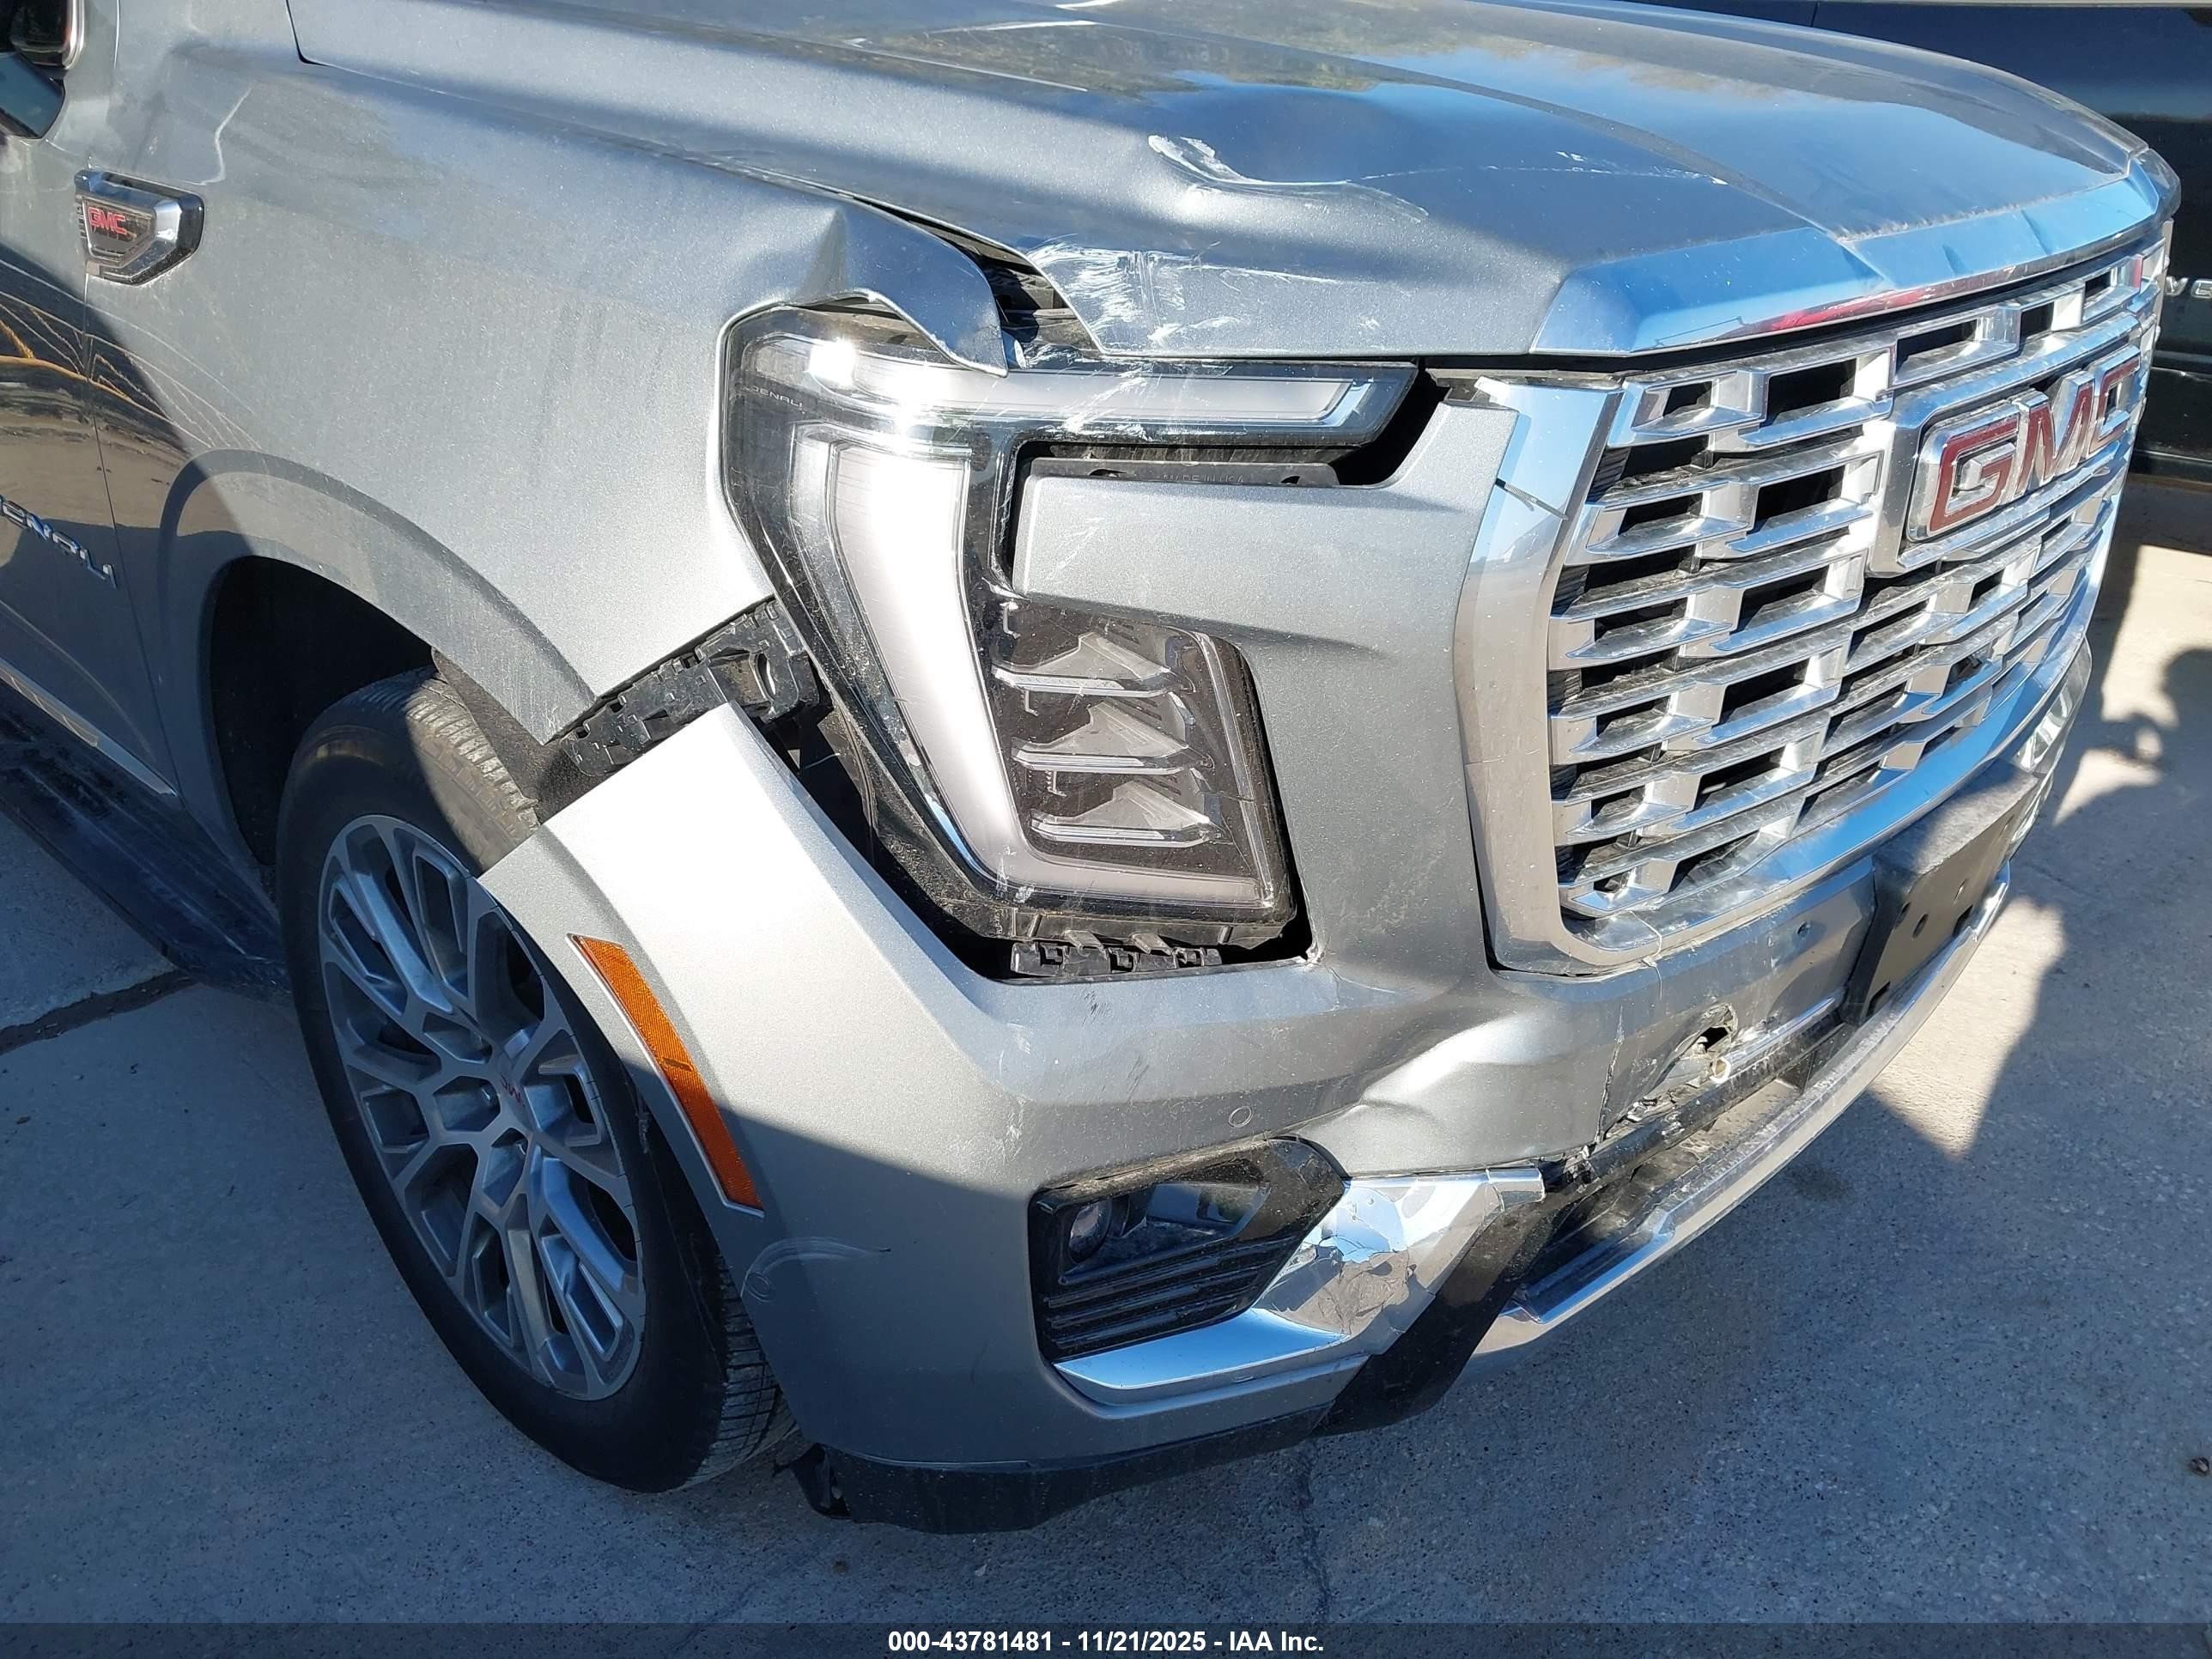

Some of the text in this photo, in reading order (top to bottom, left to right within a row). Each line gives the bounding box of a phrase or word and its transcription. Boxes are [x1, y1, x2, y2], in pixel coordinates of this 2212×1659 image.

[88, 206, 127, 236] GMC
[1919, 345, 2141, 537] GMC
[0, 495, 117, 590] ENALI
